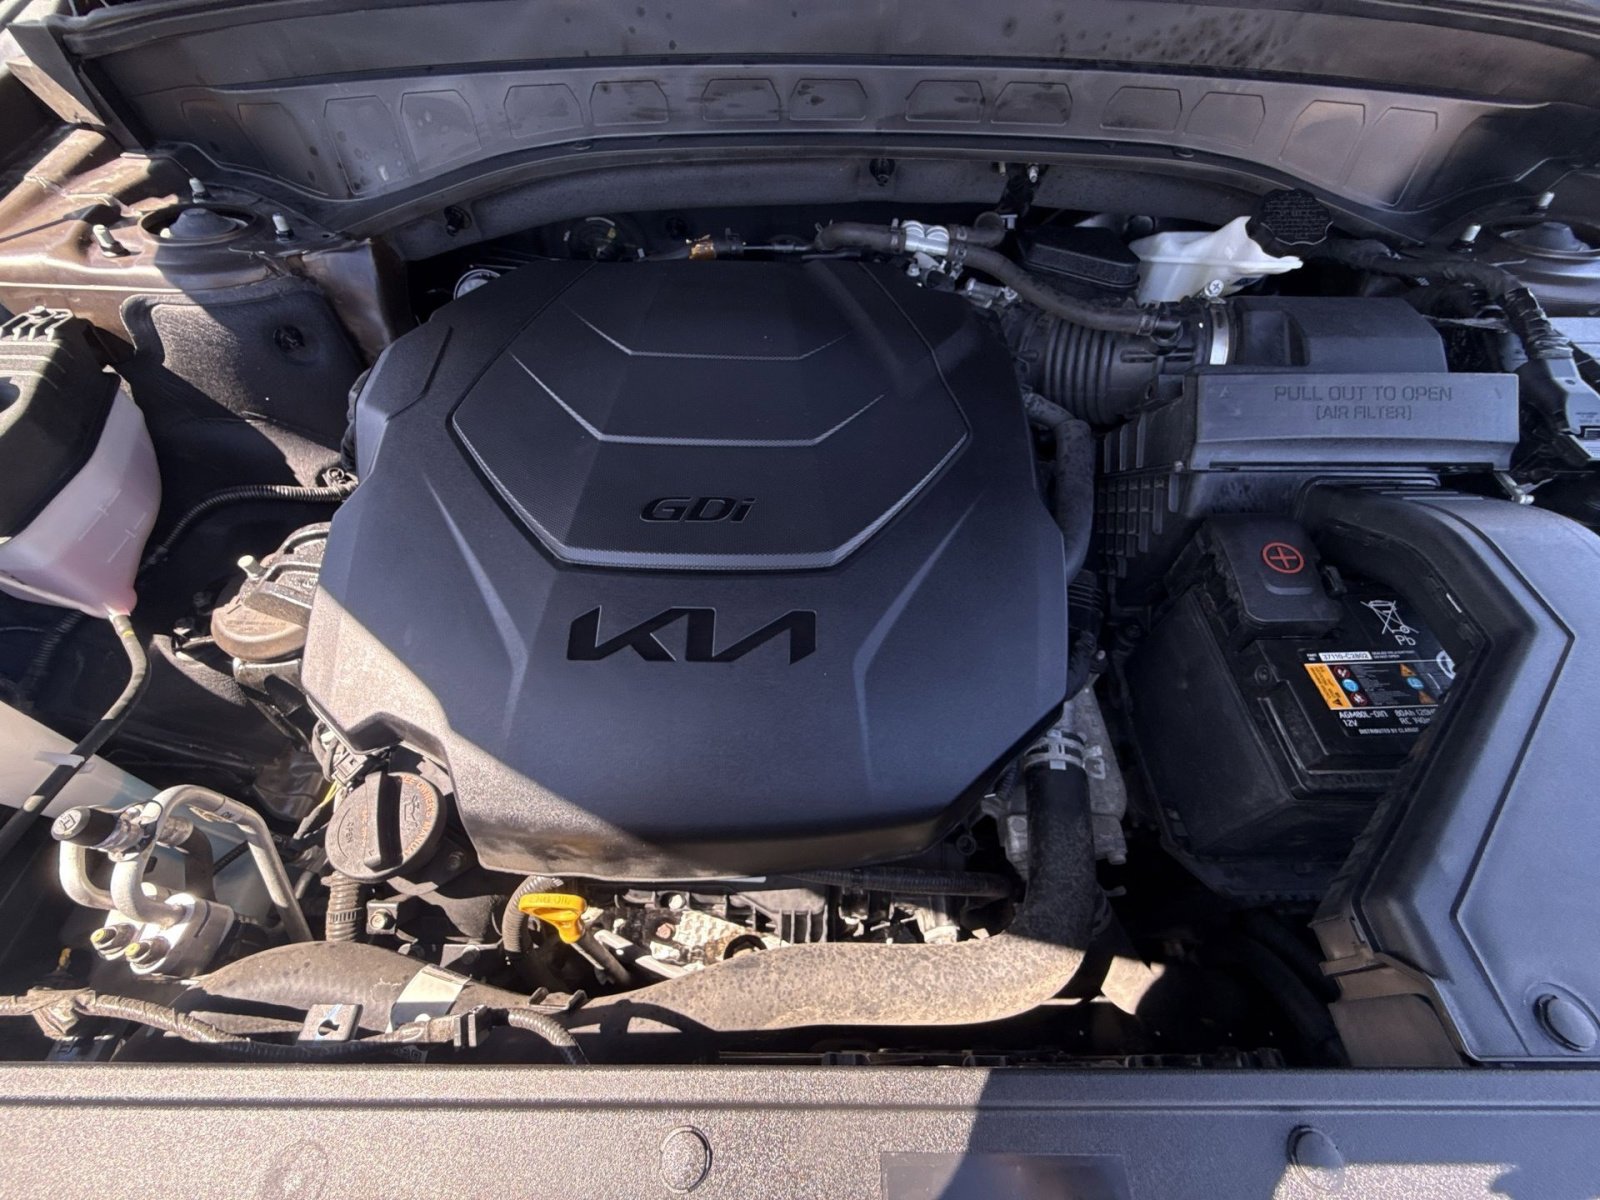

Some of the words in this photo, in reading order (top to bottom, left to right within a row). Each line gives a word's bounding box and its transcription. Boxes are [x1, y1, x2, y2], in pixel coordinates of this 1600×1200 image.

[1274, 386, 1322, 400] PULL
[1328, 386, 1367, 400] OUT
[1371, 386, 1396, 400] TO
[1401, 386, 1452, 401] OPEN
[1394, 634, 1416, 646] Pb
[1343, 719, 1358, 727] 12V
[403, 820, 434, 856] MANUA
